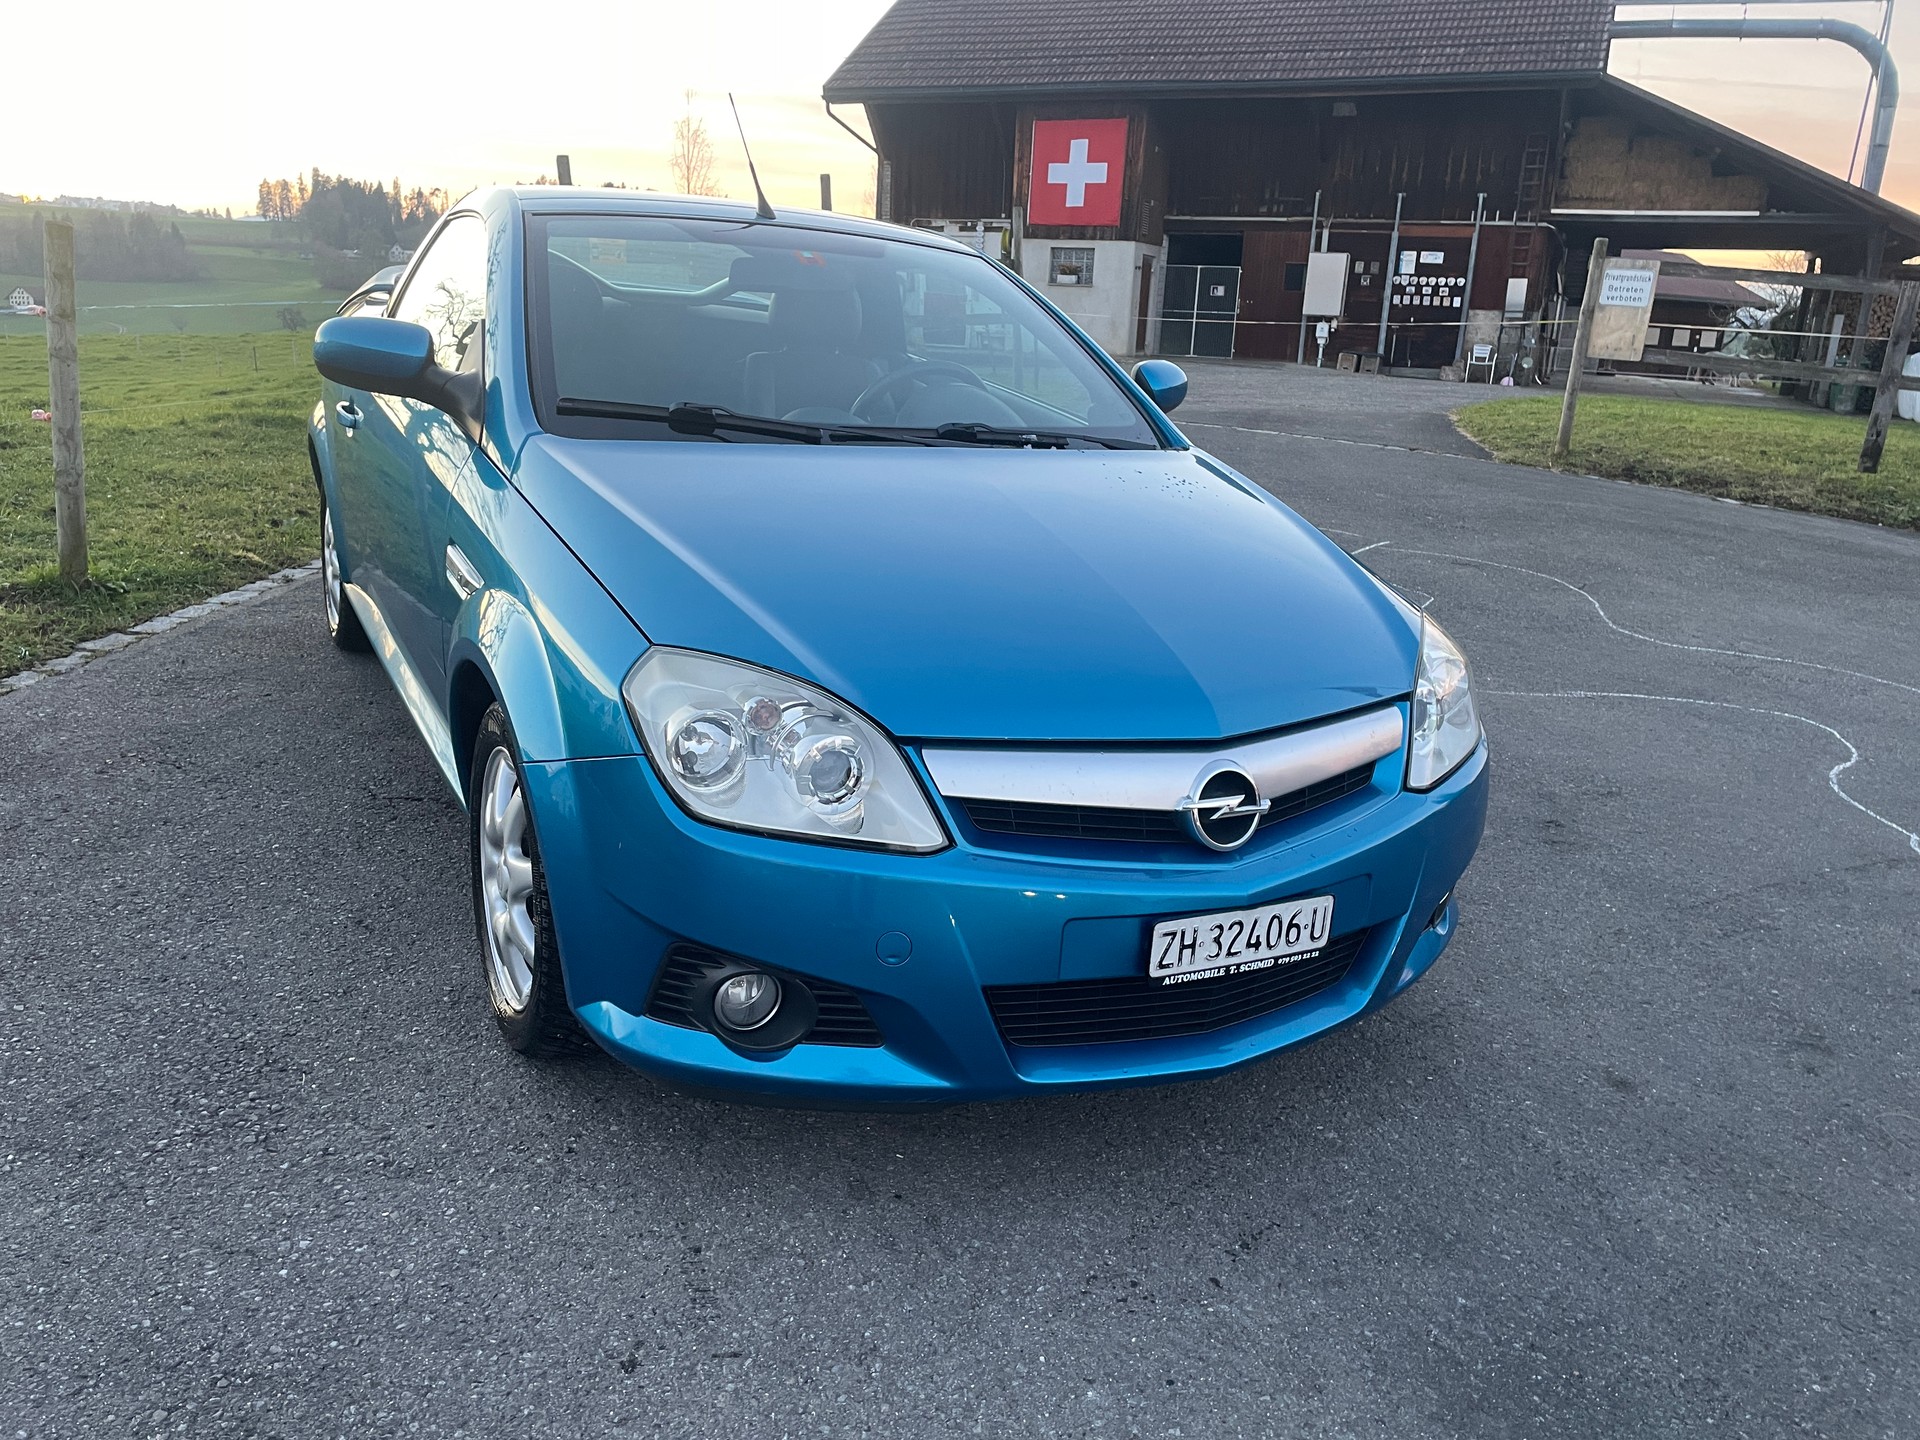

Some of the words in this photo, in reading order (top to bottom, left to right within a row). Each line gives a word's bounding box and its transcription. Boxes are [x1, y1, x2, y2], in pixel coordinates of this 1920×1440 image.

[1608, 284, 1644, 294] Betreten
[1606, 294, 1643, 303] verboten
[1162, 967, 1226, 986] AUTOMOBILE
[1229, 965, 1238, 975] T.
[1239, 958, 1275, 973] SCHMID
